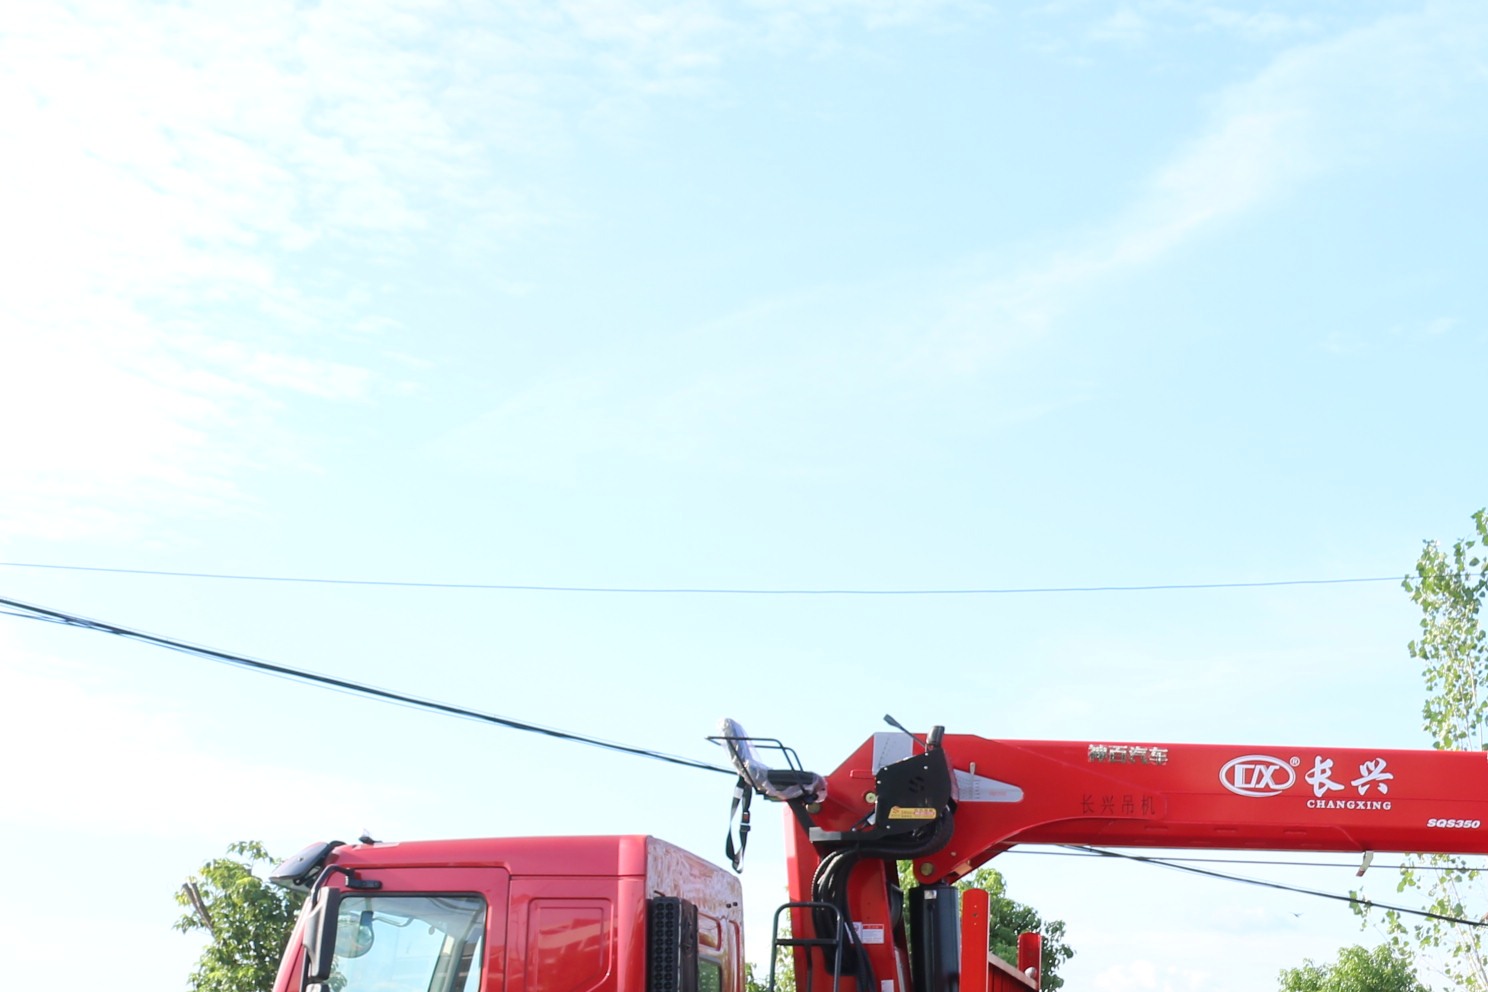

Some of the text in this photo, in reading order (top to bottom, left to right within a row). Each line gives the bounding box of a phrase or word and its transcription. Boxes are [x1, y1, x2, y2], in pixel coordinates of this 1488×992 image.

[1304, 755, 1394, 798] 长兴
[1080, 793, 1155, 815] 长兴吊机
[1306, 800, 1392, 811] CHANGXING
[1427, 818, 1481, 829] SQS350
